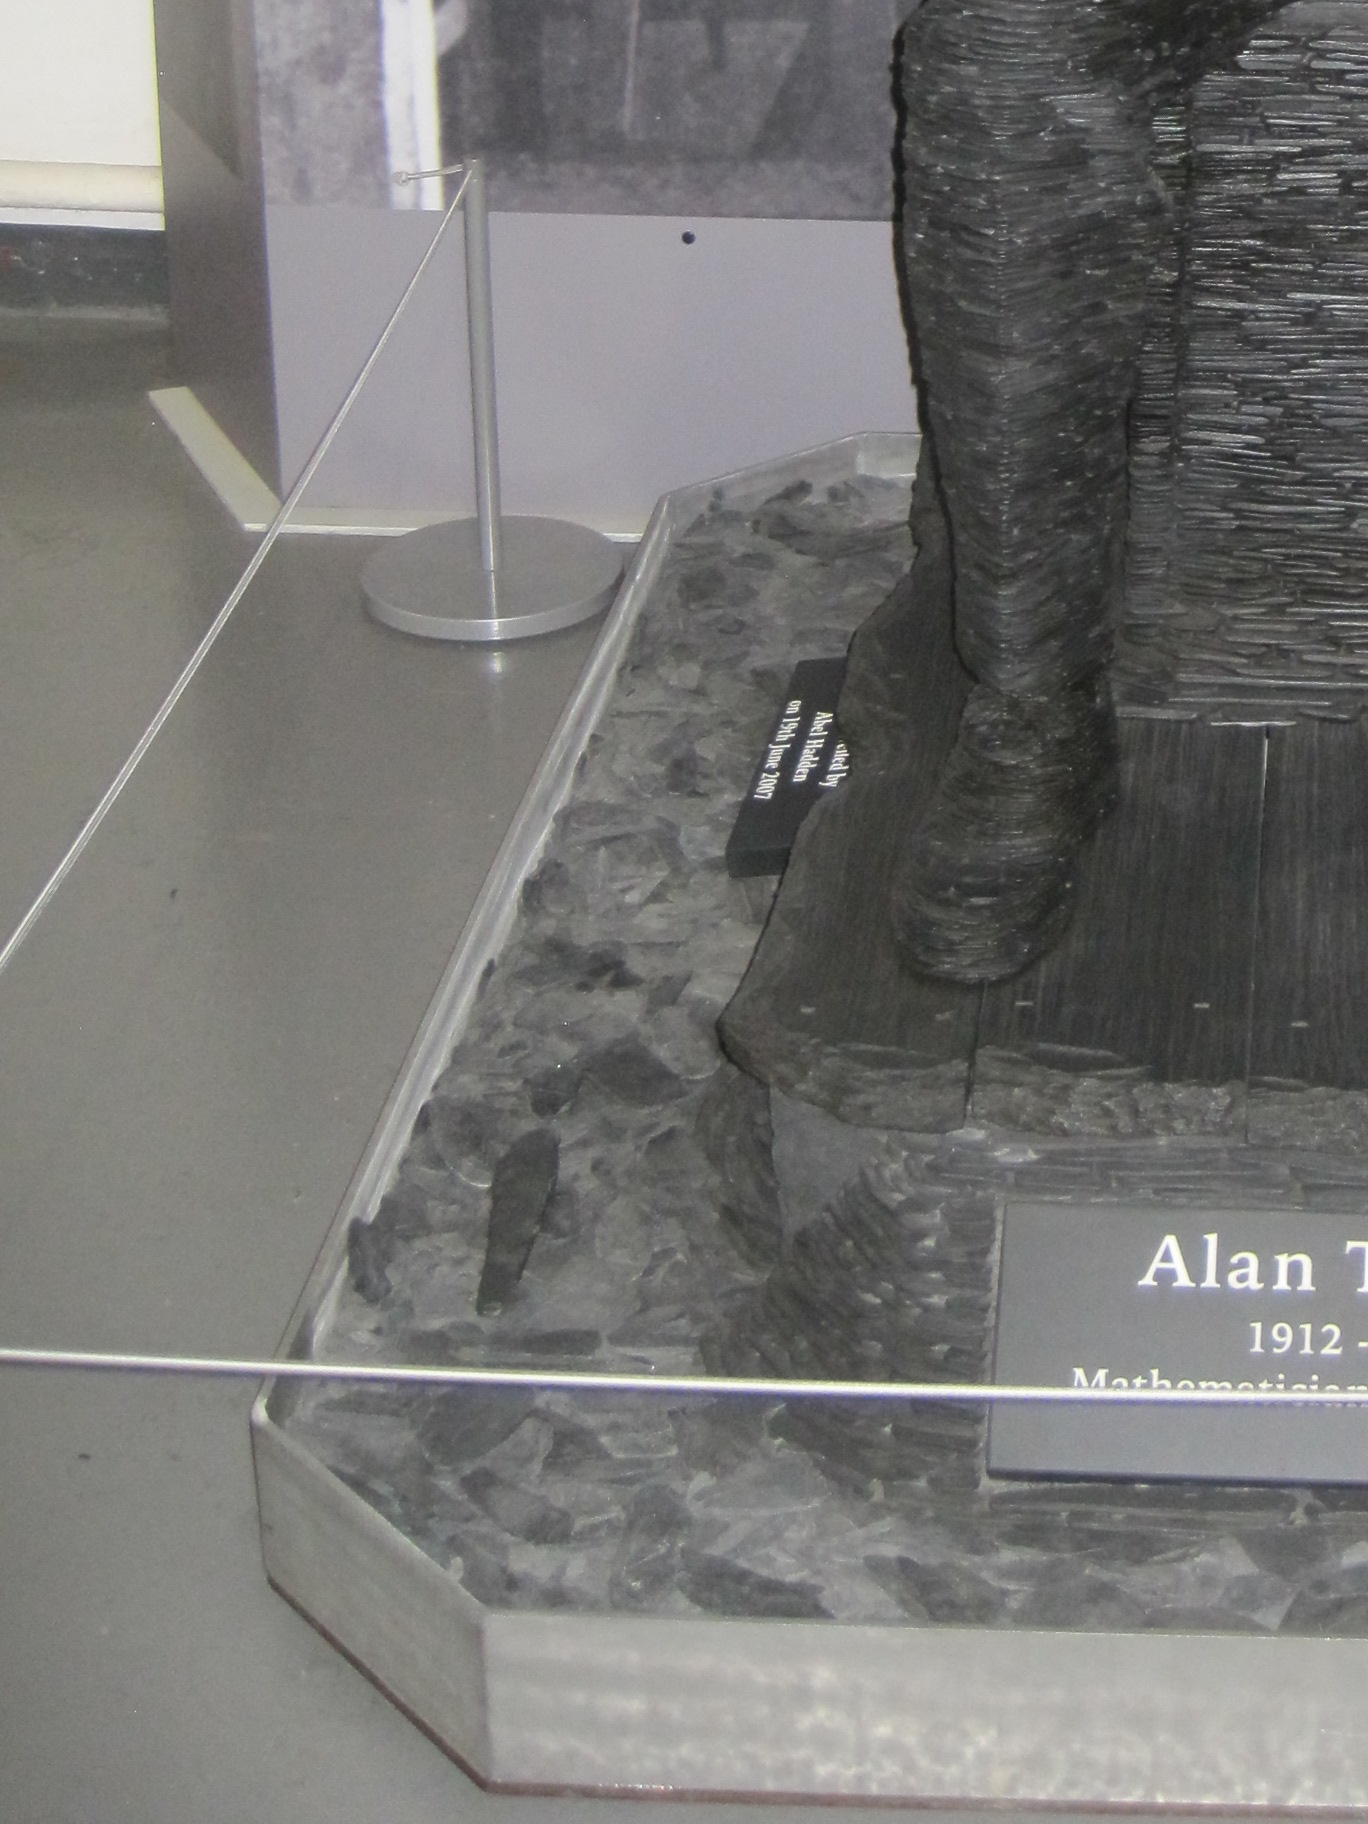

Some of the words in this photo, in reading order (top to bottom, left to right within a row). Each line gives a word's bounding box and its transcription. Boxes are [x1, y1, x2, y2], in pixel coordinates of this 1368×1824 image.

[785, 699, 802, 714] on
[775, 716, 801, 742] 19th
[809, 711, 834, 737] Abel
[764, 743, 792, 769] June
[792, 738, 825, 782] Hadden
[753, 771, 781, 800] 2007
[818, 772, 847, 788] by
[1136, 1232, 1317, 1293] Alan
[1248, 1321, 1343, 1356] 1912
